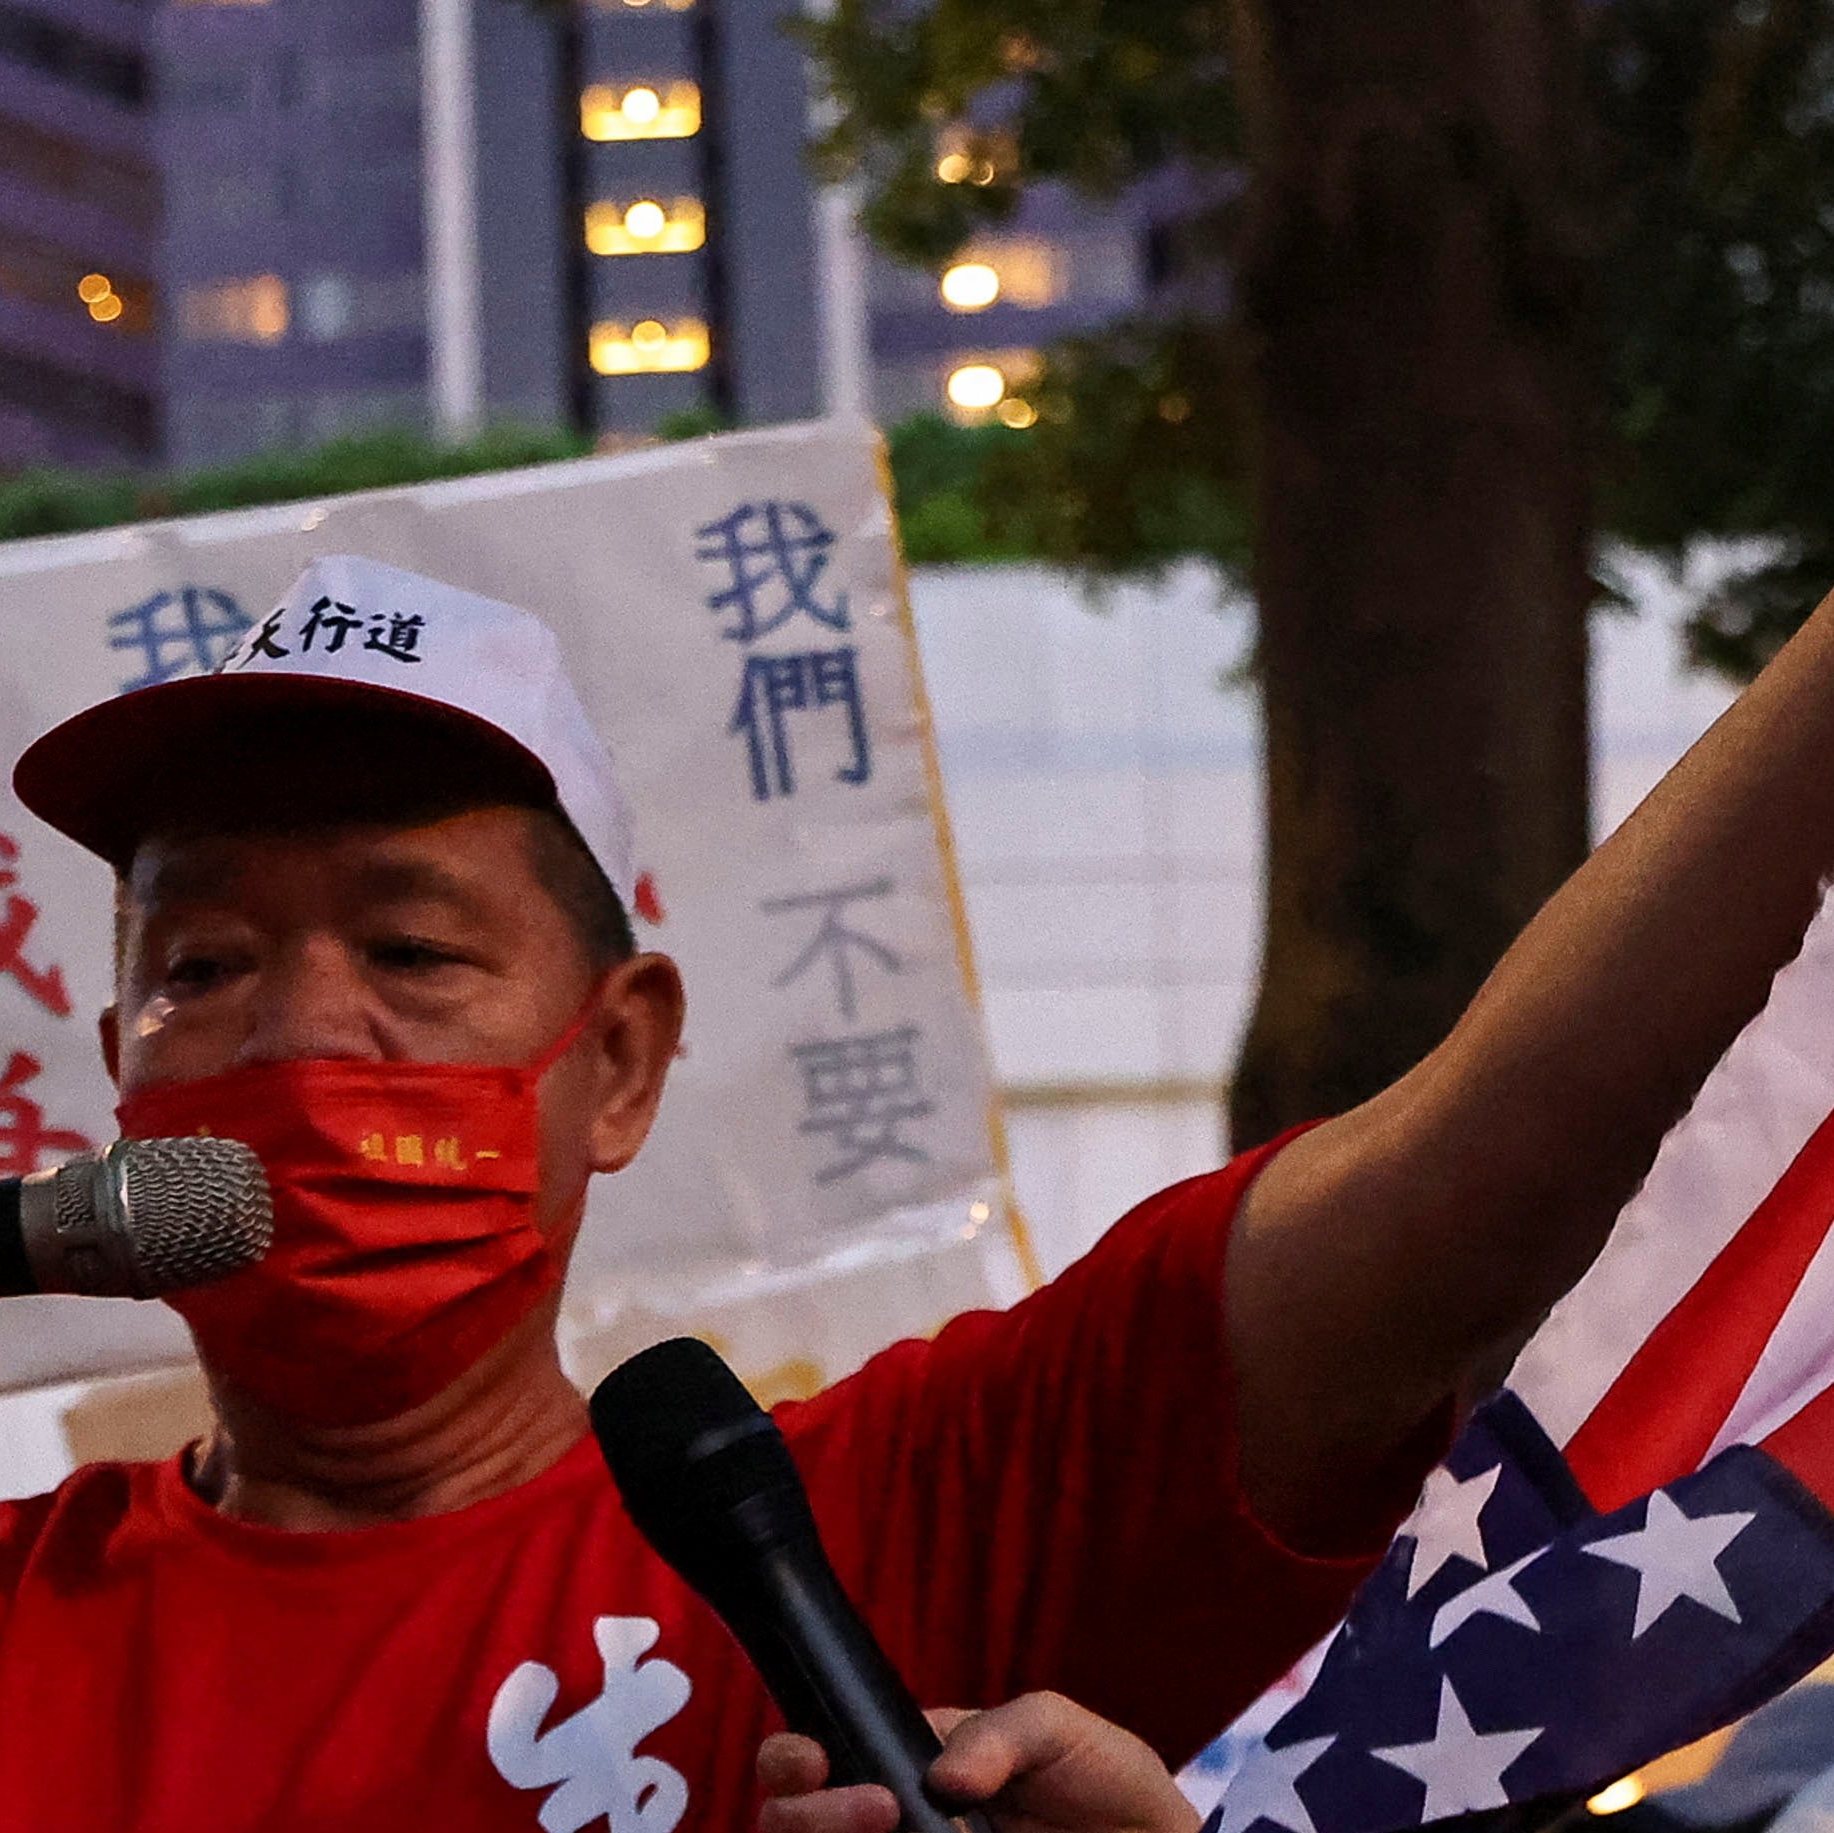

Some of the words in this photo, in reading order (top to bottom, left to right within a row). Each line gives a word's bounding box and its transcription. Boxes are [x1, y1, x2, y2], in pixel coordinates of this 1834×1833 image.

[217, 596, 427, 666] 天行道
[694, 499, 938, 1188] 我們不要
